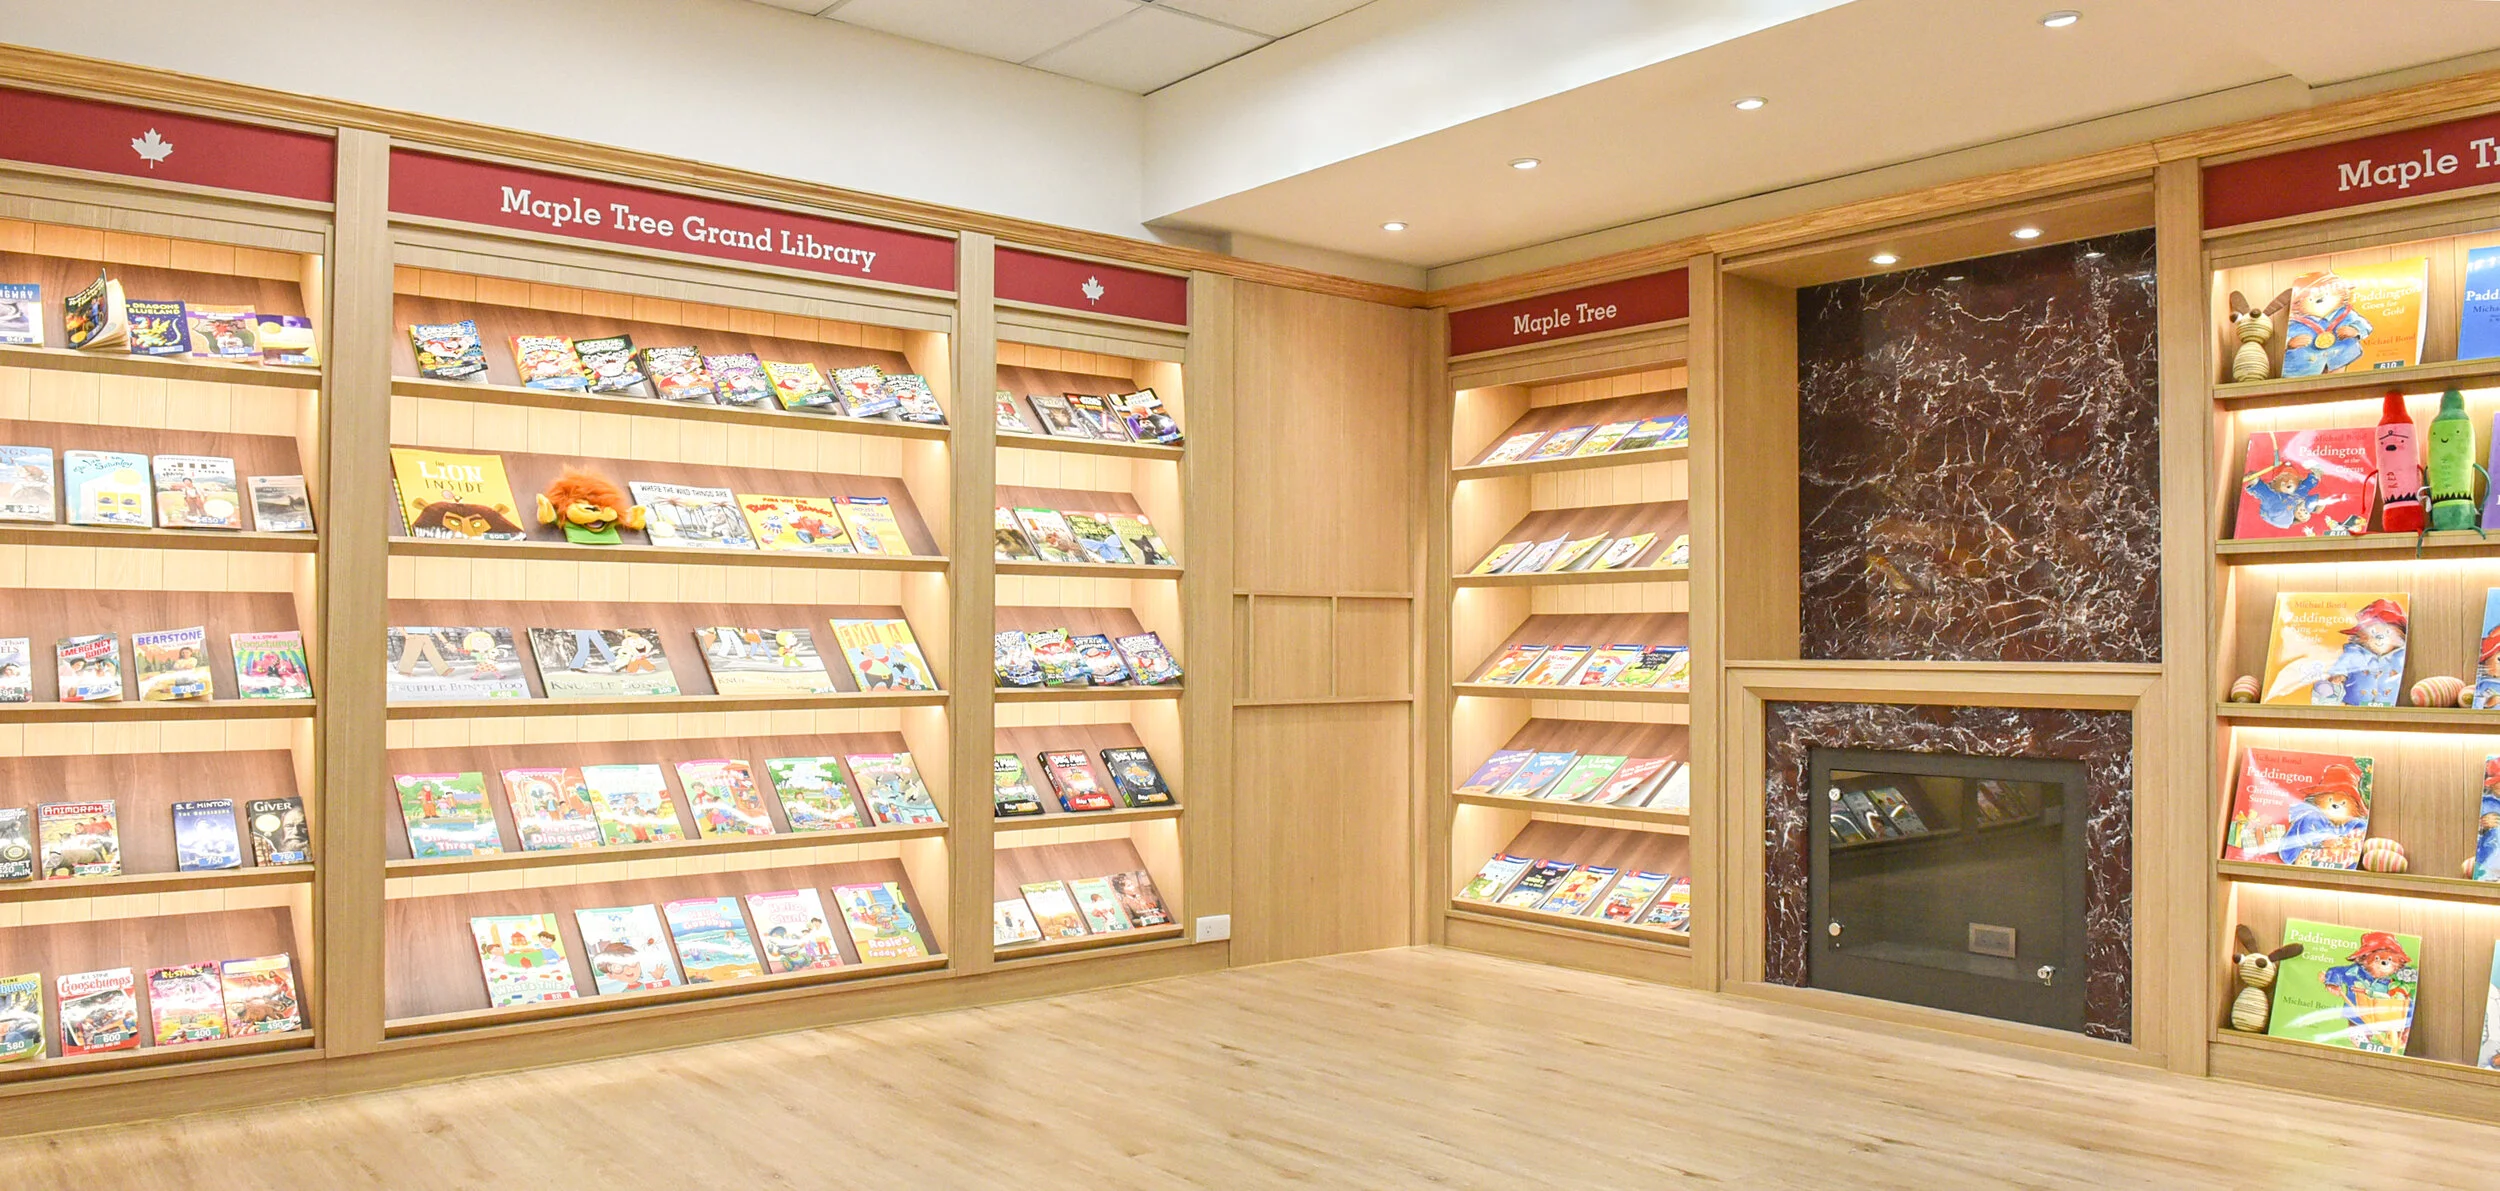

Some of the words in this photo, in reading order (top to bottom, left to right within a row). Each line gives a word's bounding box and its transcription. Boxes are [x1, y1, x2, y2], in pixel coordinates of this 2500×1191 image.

[2338, 148, 2458, 192] Maple
[501, 185, 601, 227] Maple
[609, 203, 674, 237] Tree
[682, 215, 773, 252] Grand
[780, 229, 876, 273] Library
[2352, 284, 2423, 303] Paddington
[2361, 301, 2385, 311] Goes
[2382, 307, 2405, 317] Gold
[1514, 309, 1571, 335] Maple
[1576, 303, 1617, 324] Tree
[2363, 335, 2394, 347] Michael
[2299, 446, 2366, 458] Paddington
[425, 479, 484, 493] INSIDE
[640, 484, 662, 493] WHERE
[676, 488, 691, 496] WILD
[692, 489, 714, 497] THINGS
[2294, 600, 2324, 609] Michael
[2326, 600, 2347, 609] Bond
[138, 630, 203, 646] BEARSTONE
[59, 638, 111, 658] EMERGENCY
[497, 682, 523, 690] TOO
[1052, 754, 1069, 763] DOG
[1112, 752, 1129, 761] DOG
[1130, 751, 1148, 761] MAN
[2246, 766, 2313, 784] Paddington
[2246, 785, 2289, 798] Christmas
[2248, 793, 2285, 806] Surprise
[531, 830, 597, 844] Dinosaur
[435, 840, 476, 851] Three
[2290, 929, 2358, 951] Paddington
[2302, 951, 2335, 964] Garden
[61, 975, 131, 995] Goosebumps
[493, 983, 537, 995] What's
[539, 981, 570, 991] This?
[2283, 995, 2314, 1008] Michael
[2366, 1043, 2384, 1052] 610
